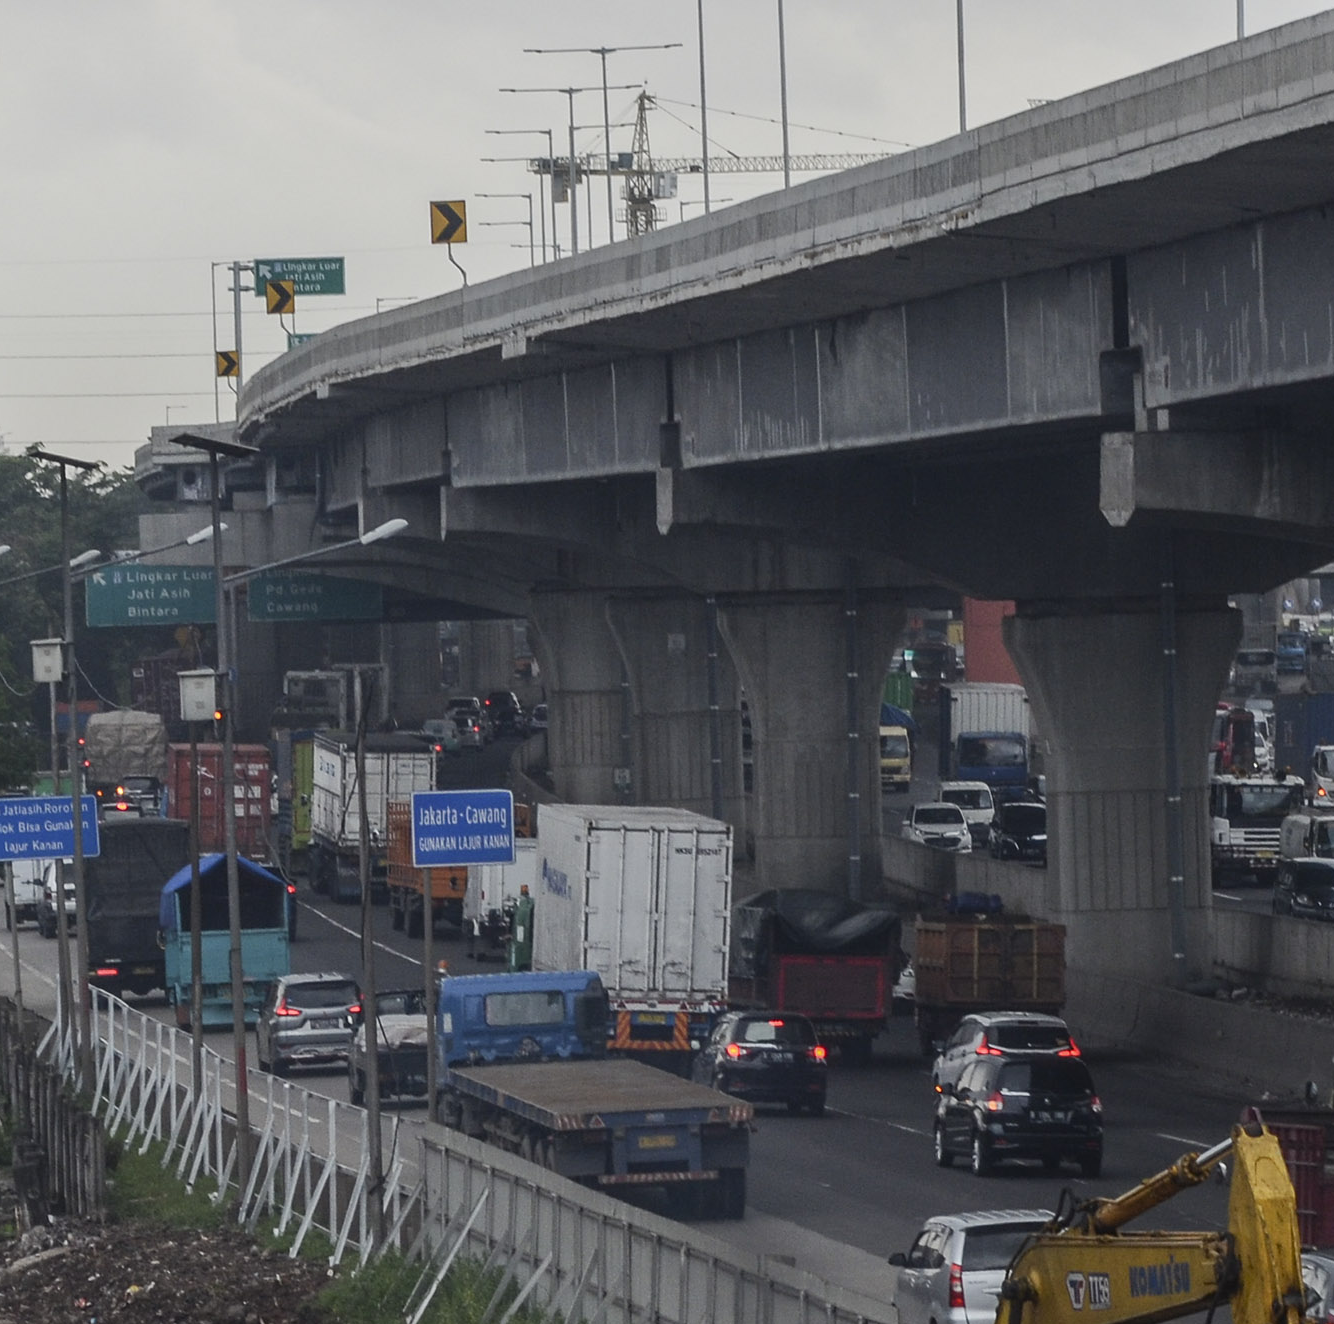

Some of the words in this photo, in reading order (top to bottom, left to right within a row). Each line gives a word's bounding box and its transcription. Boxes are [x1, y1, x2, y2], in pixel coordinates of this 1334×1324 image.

[282, 262, 316, 272] Lingkar
[319, 261, 340, 271] Luar
[305, 273, 325, 281] Asih
[126, 571, 178, 584] Lingkar
[183, 570, 213, 582] Luar
[127, 588, 156, 600] Jati
[161, 587, 191, 599] Asih
[127, 606, 179, 618] Bintara
[267, 601, 318, 614] Cawang
[419, 805, 458, 826] Jakarta
[465, 805, 507, 828] Cawang
[18, 821, 41, 833] Bisa
[32, 840, 64, 851] Kanan
[419, 836, 457, 852] GUNAKAN
[458, 835, 482, 850] LAJUR
[483, 834, 510, 849] KANAN
[1129, 1253, 1190, 1298] KOMATSU
